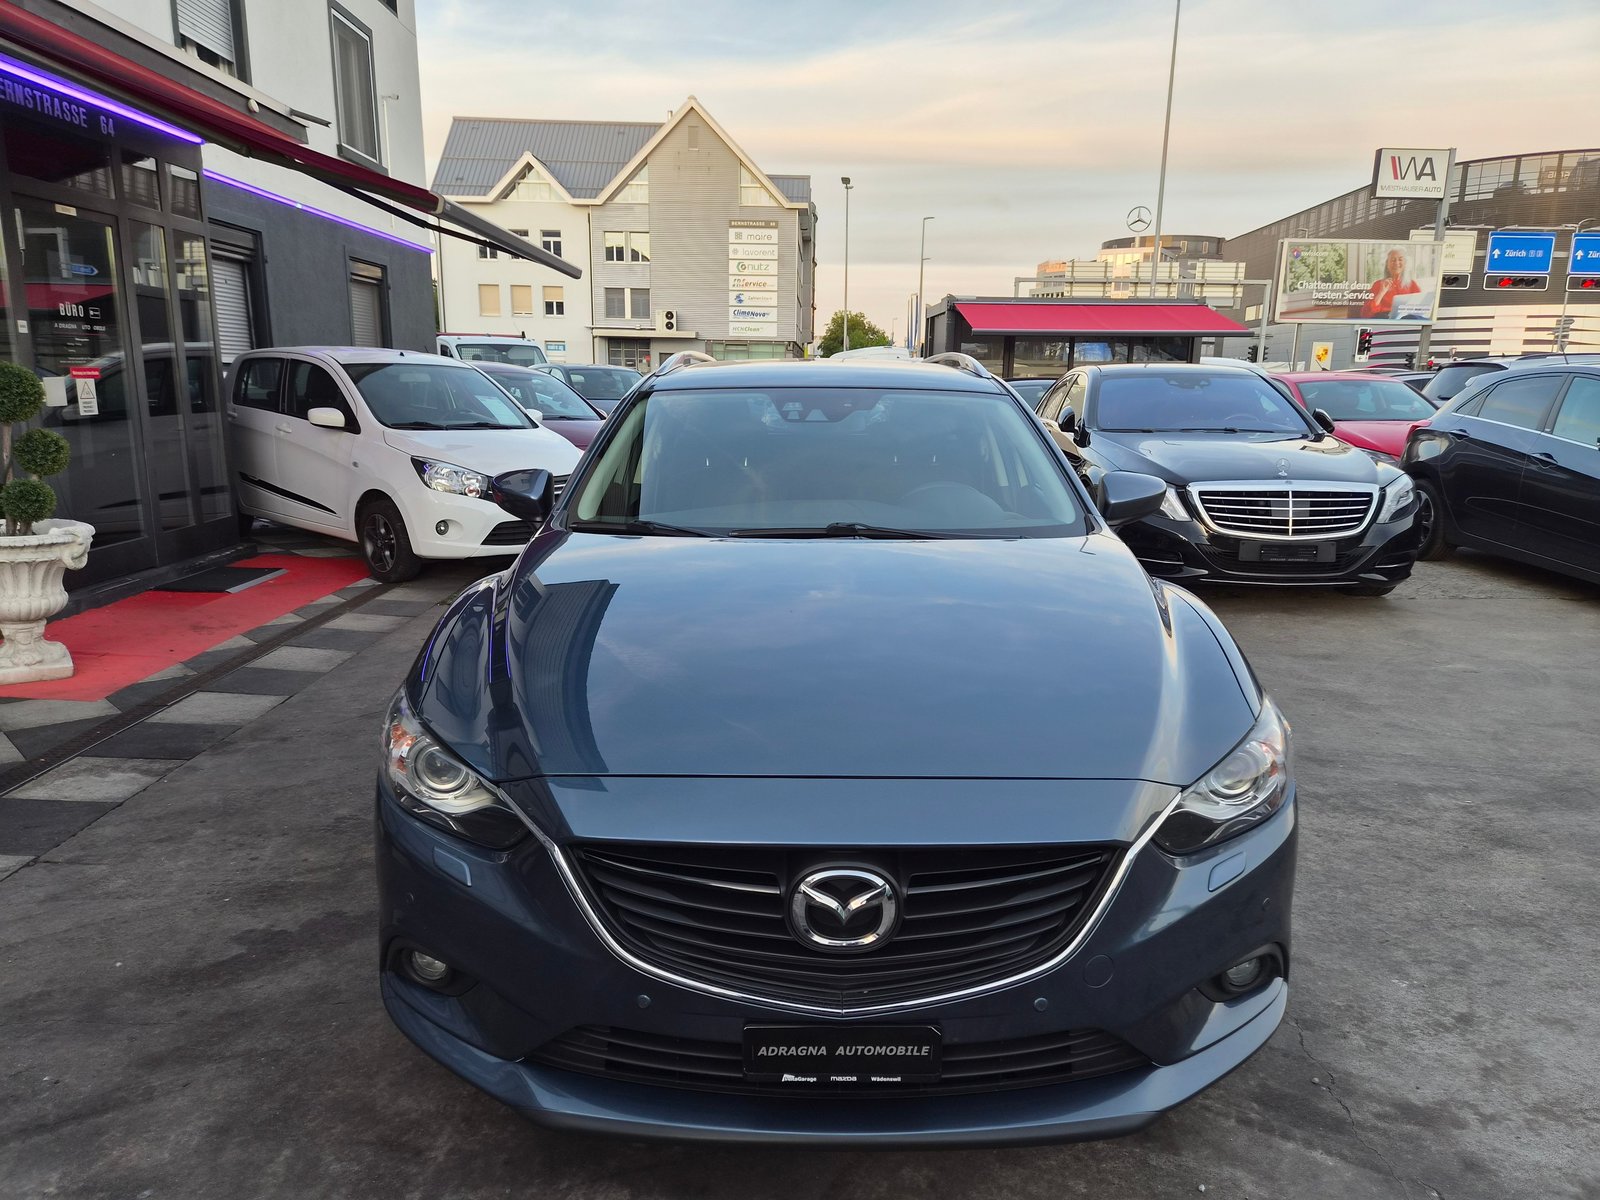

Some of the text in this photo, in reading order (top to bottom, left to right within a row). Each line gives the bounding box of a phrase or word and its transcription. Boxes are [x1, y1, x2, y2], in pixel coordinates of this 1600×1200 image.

[100, 115, 115, 137] 64
[742, 248, 776, 256] lavorent
[1504, 249, 1527, 257] Zürich
[1297, 280, 1371, 290] Chatten mit dem
[1312, 290, 1375, 300] besten Service
[59, 301, 84, 317] BÜRO
[757, 1046, 930, 1056] ADRAGNA AUTOMOBILE
